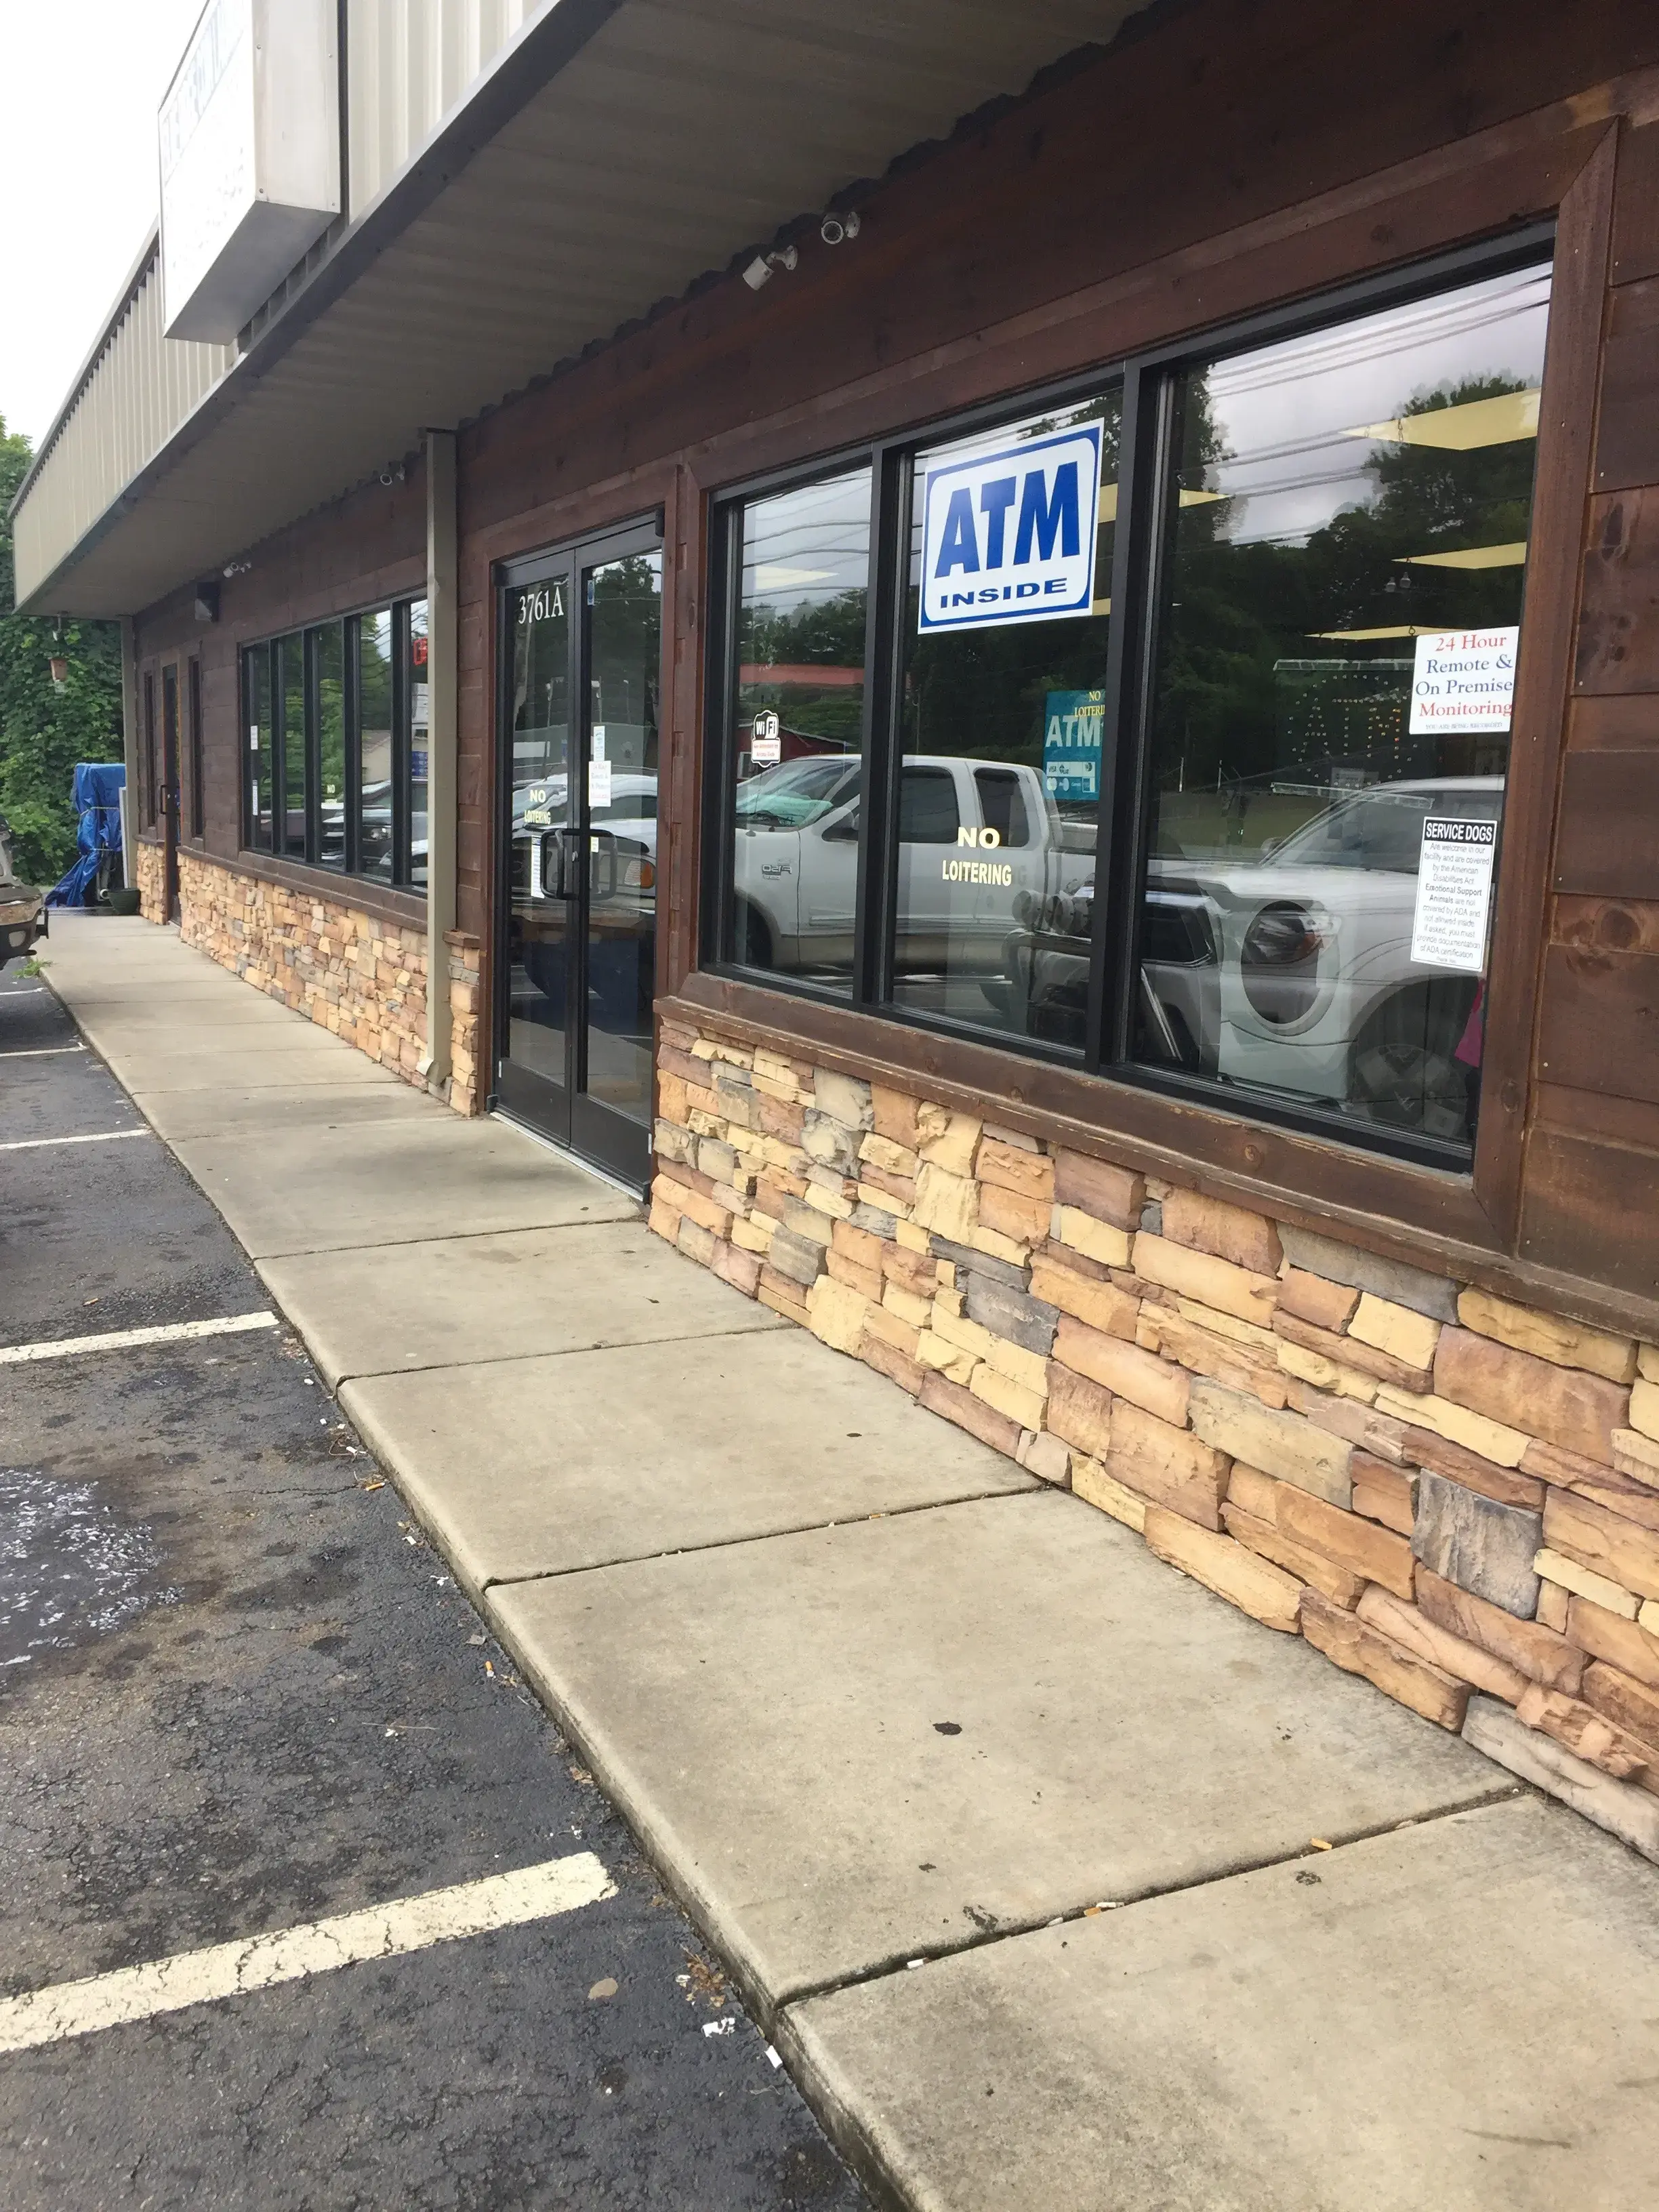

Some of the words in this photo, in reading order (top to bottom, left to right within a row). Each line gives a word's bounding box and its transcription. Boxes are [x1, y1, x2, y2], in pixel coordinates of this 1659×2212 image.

[934, 461, 1080, 579] ATM
[940, 577, 1067, 609] INSIDE
[518, 586, 565, 624] 3761A
[1435, 636, 1456, 652] 24
[1461, 634, 1507, 650] Hour
[1426, 659, 1490, 674] Remote
[1496, 653, 1513, 669] &
[1416, 681, 1440, 696] On
[1446, 678, 1513, 694] Premise
[1089, 691, 1101, 702] NO
[1419, 700, 1513, 717] Monitoring
[1046, 715, 1101, 747] ATM
[530, 789, 546, 803] NO
[524, 810, 551, 825] LOITERING
[958, 827, 1000, 849] NO
[1426, 822, 1465, 840] SERVICE
[1465, 825, 1492, 842] DOGS
[1430, 842, 1440, 851] Are
[1441, 844, 1467, 853] welcome
[1425, 853, 1441, 862] facility
[1466, 857, 1490, 865] covered
[942, 859, 1012, 886] LOITERING
[1433, 864, 1440, 873] by
[1450, 865, 1479, 874] American
[1426, 883, 1455, 894] Emotional
[1457, 886, 1482, 897] Support
[1429, 894, 1454, 904] Animals
[1422, 905, 1446, 914] covered
[1446, 907, 1453, 916] by
[1454, 907, 1468, 916] ADA
[1427, 945, 1439, 954] ADA
[1440, 948, 1473, 958] certification
